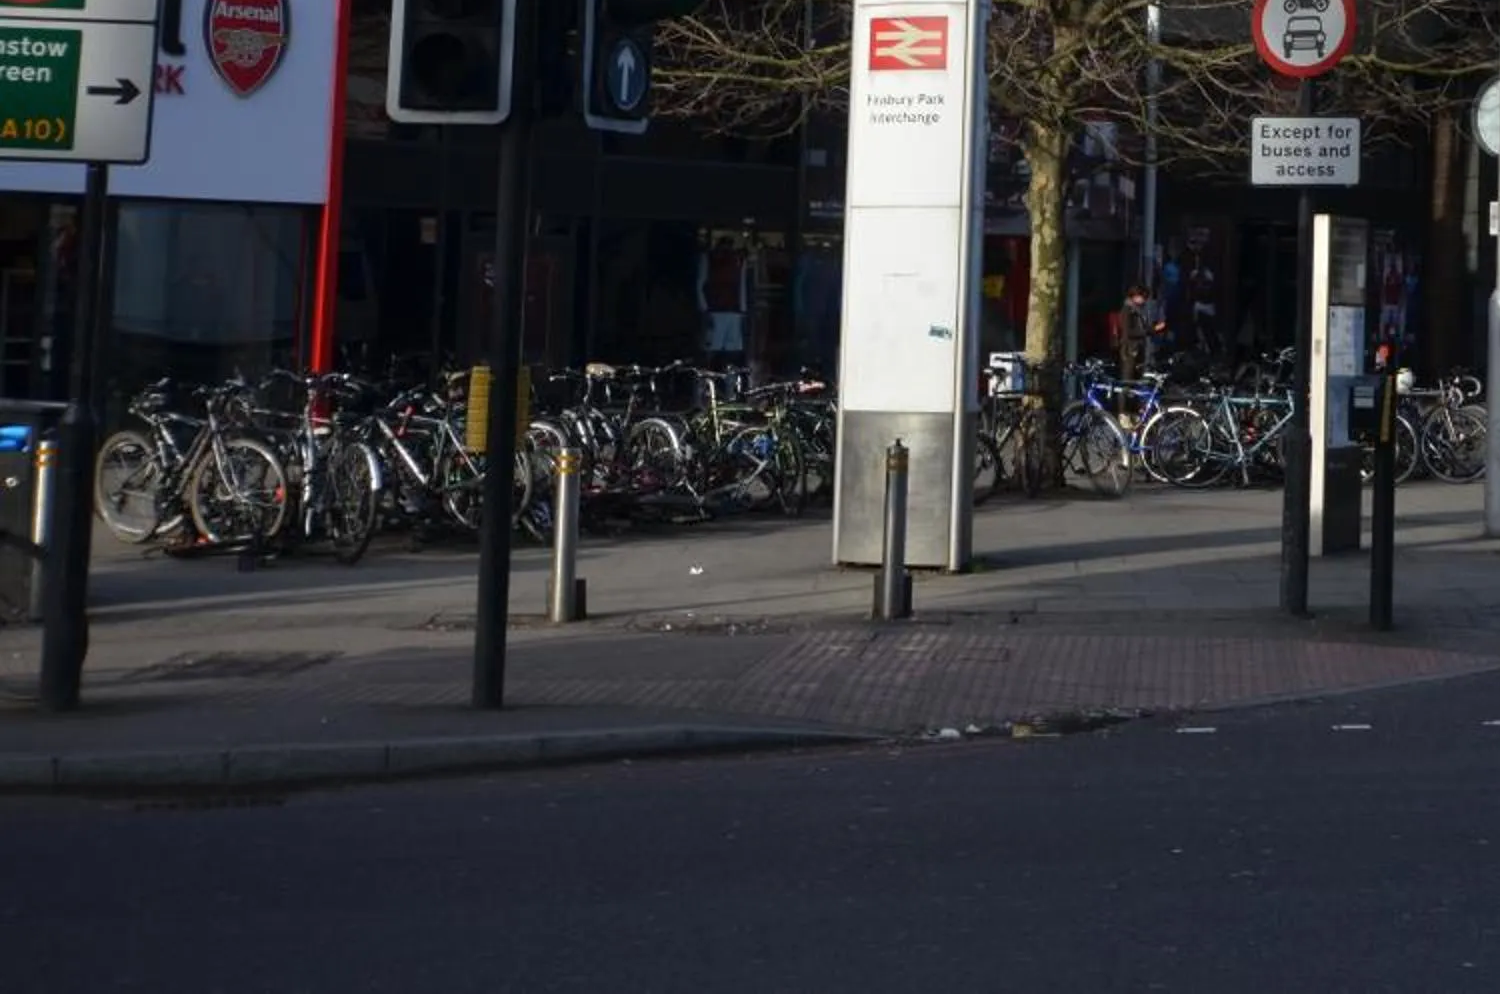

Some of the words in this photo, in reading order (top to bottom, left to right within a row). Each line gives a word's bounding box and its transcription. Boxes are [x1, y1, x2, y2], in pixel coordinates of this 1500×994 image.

[213, 1, 280, 22] Arsenal
[918, 93, 945, 105] Park
[1261, 124, 1321, 141] Except
[1327, 125, 1352, 139] for
[1261, 144, 1313, 158] buses
[1318, 144, 1351, 158] and
[1275, 164, 1335, 177] access
